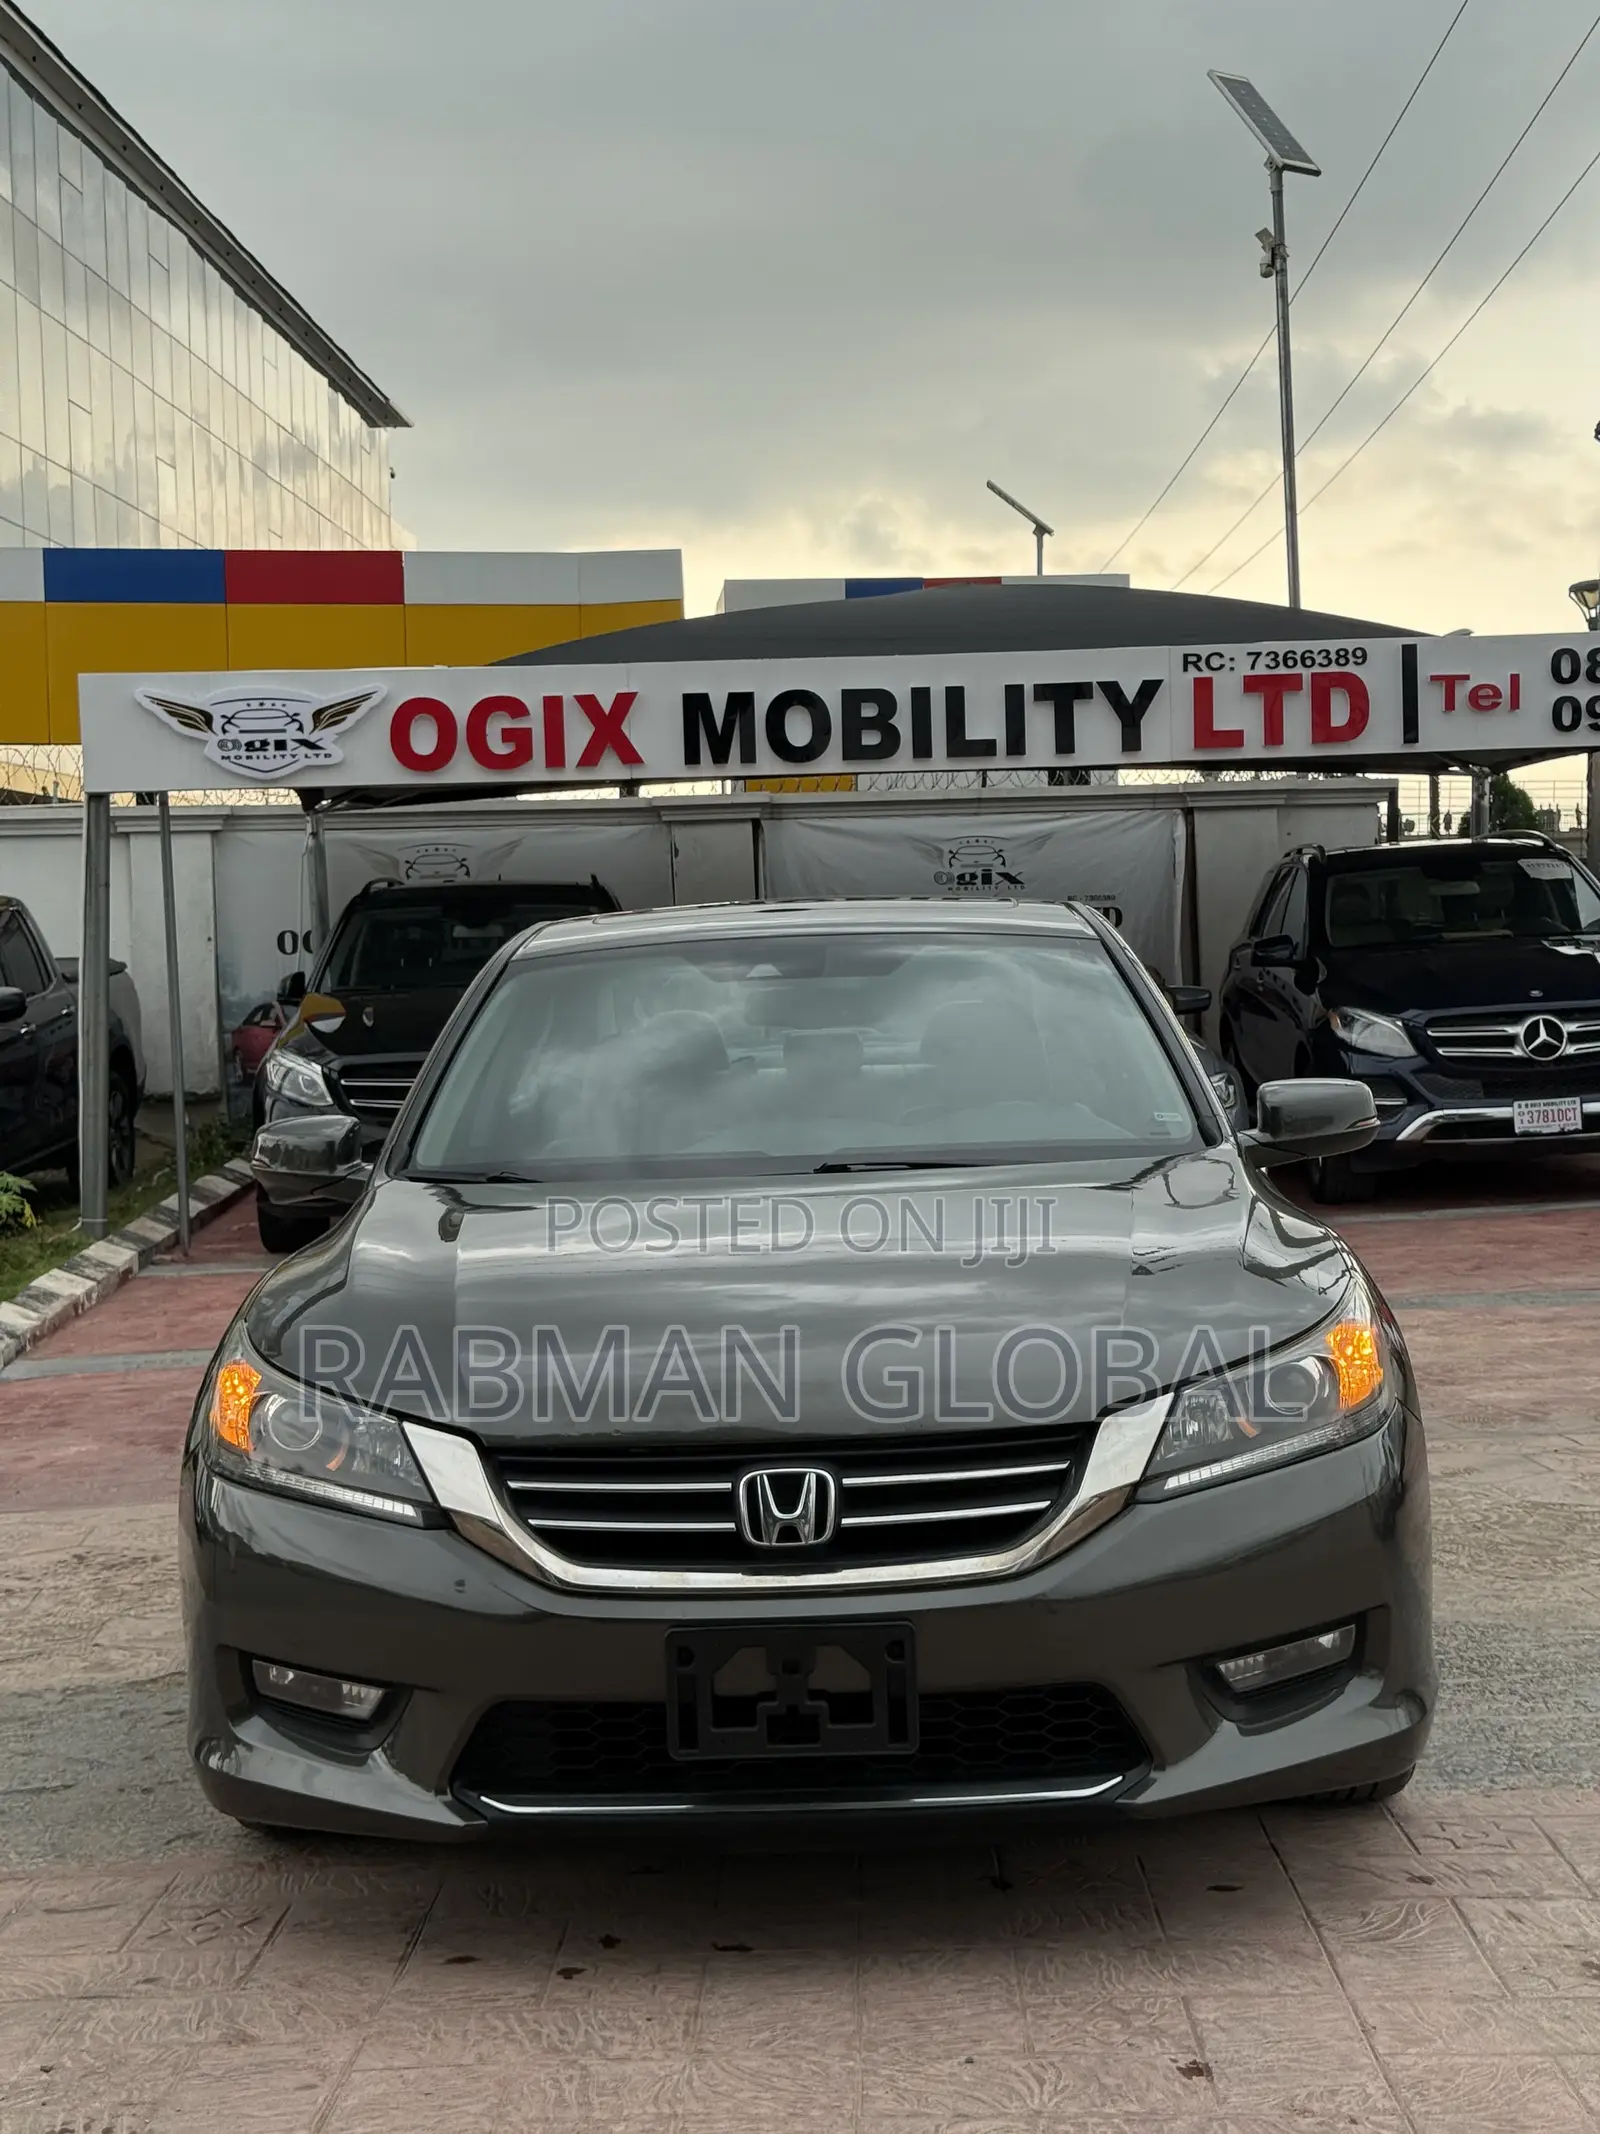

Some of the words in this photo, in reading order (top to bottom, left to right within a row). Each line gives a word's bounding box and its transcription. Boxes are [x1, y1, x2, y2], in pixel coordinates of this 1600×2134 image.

[1182, 652, 1236, 673] RC:
[1246, 646, 1368, 671] 7366389
[1550, 647, 1600, 685] 08
[1429, 673, 1521, 713] Tel
[390, 691, 645, 772] OGIX
[682, 678, 1165, 766] MOBILITY
[1193, 670, 1371, 750] LTD
[1551, 694, 1600, 733] 09
[304, 752, 332, 760] LTD
